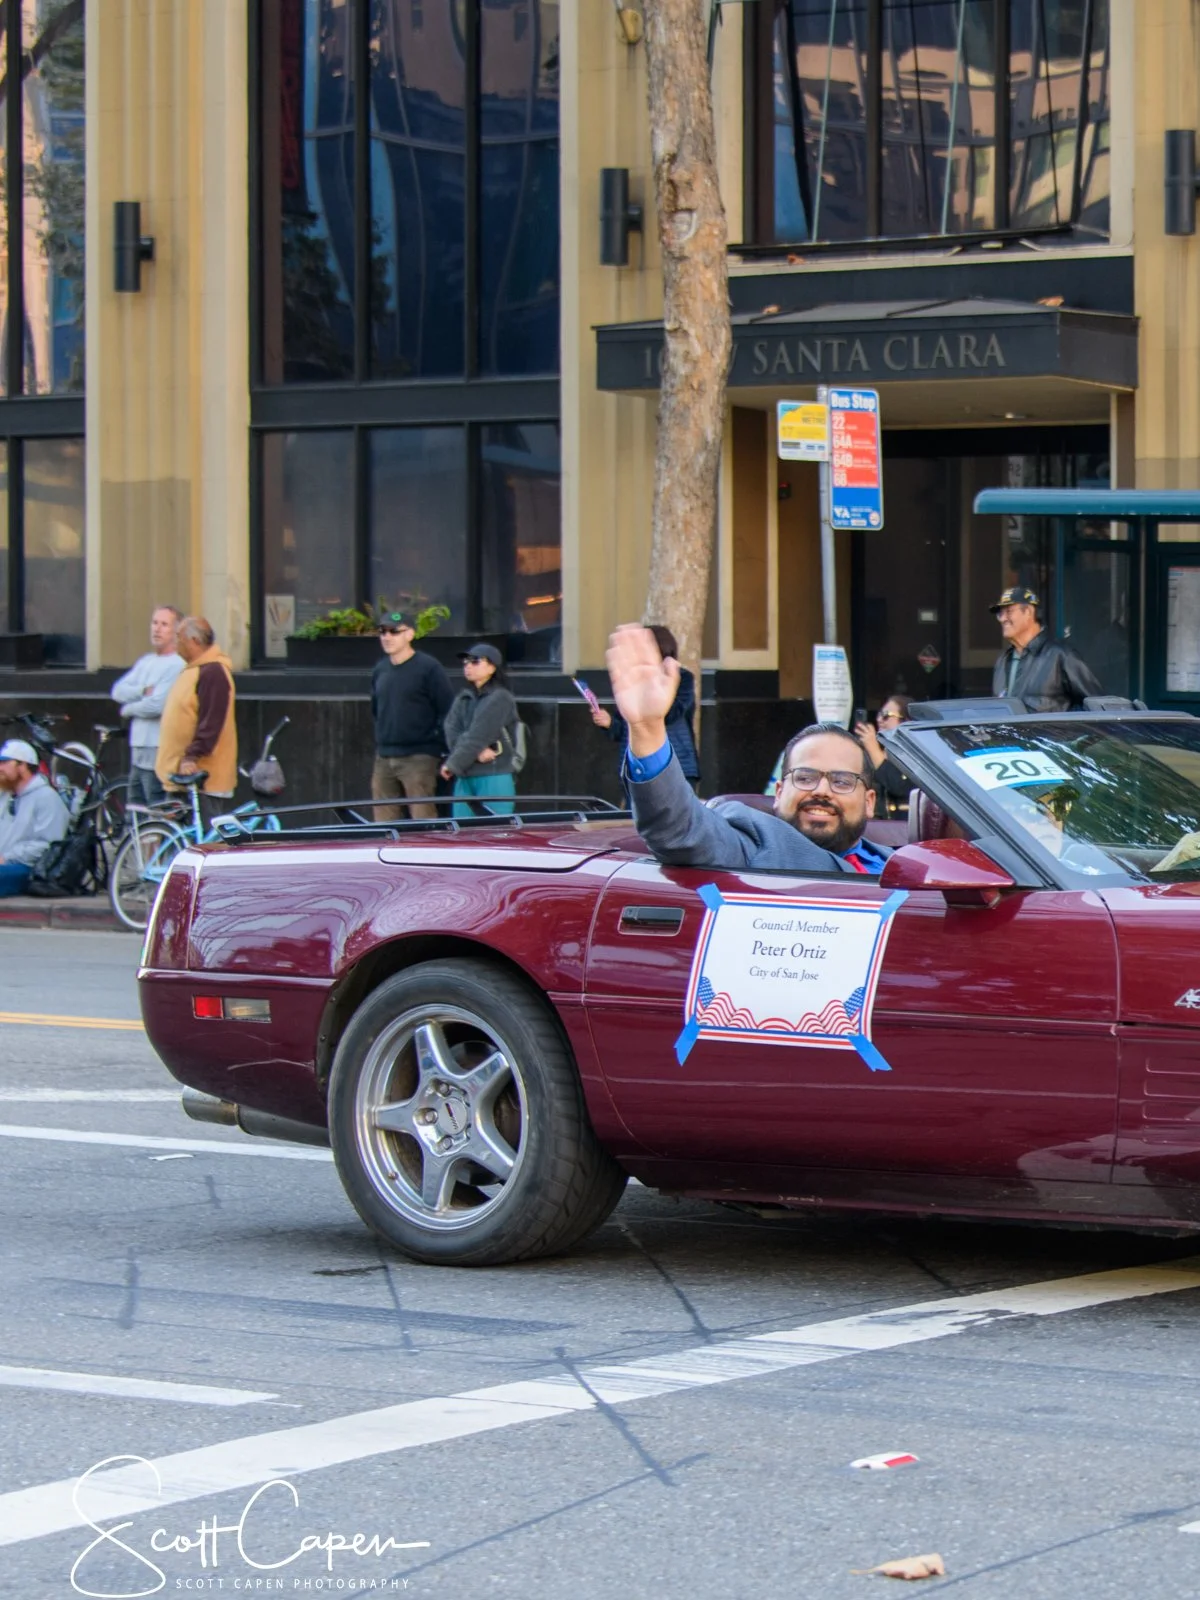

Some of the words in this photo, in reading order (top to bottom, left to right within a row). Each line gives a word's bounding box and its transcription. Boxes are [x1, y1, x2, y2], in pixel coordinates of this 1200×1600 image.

[753, 338, 870, 375] SANTA
[883, 333, 1008, 371] CLARA
[831, 392, 850, 408] Bus
[852, 393, 876, 411] Stop
[832, 415, 845, 430] 22
[833, 434, 853, 449] 64A
[984, 759, 1041, 781] 20
[752, 918, 794, 931] Council
[795, 920, 840, 934] Member
[751, 940, 787, 957] Peter
[790, 942, 827, 959] Ortiz
[749, 966, 769, 981] City
[771, 967, 782, 979] of
[783, 968, 799, 980] San
[800, 968, 819, 982] Jose
